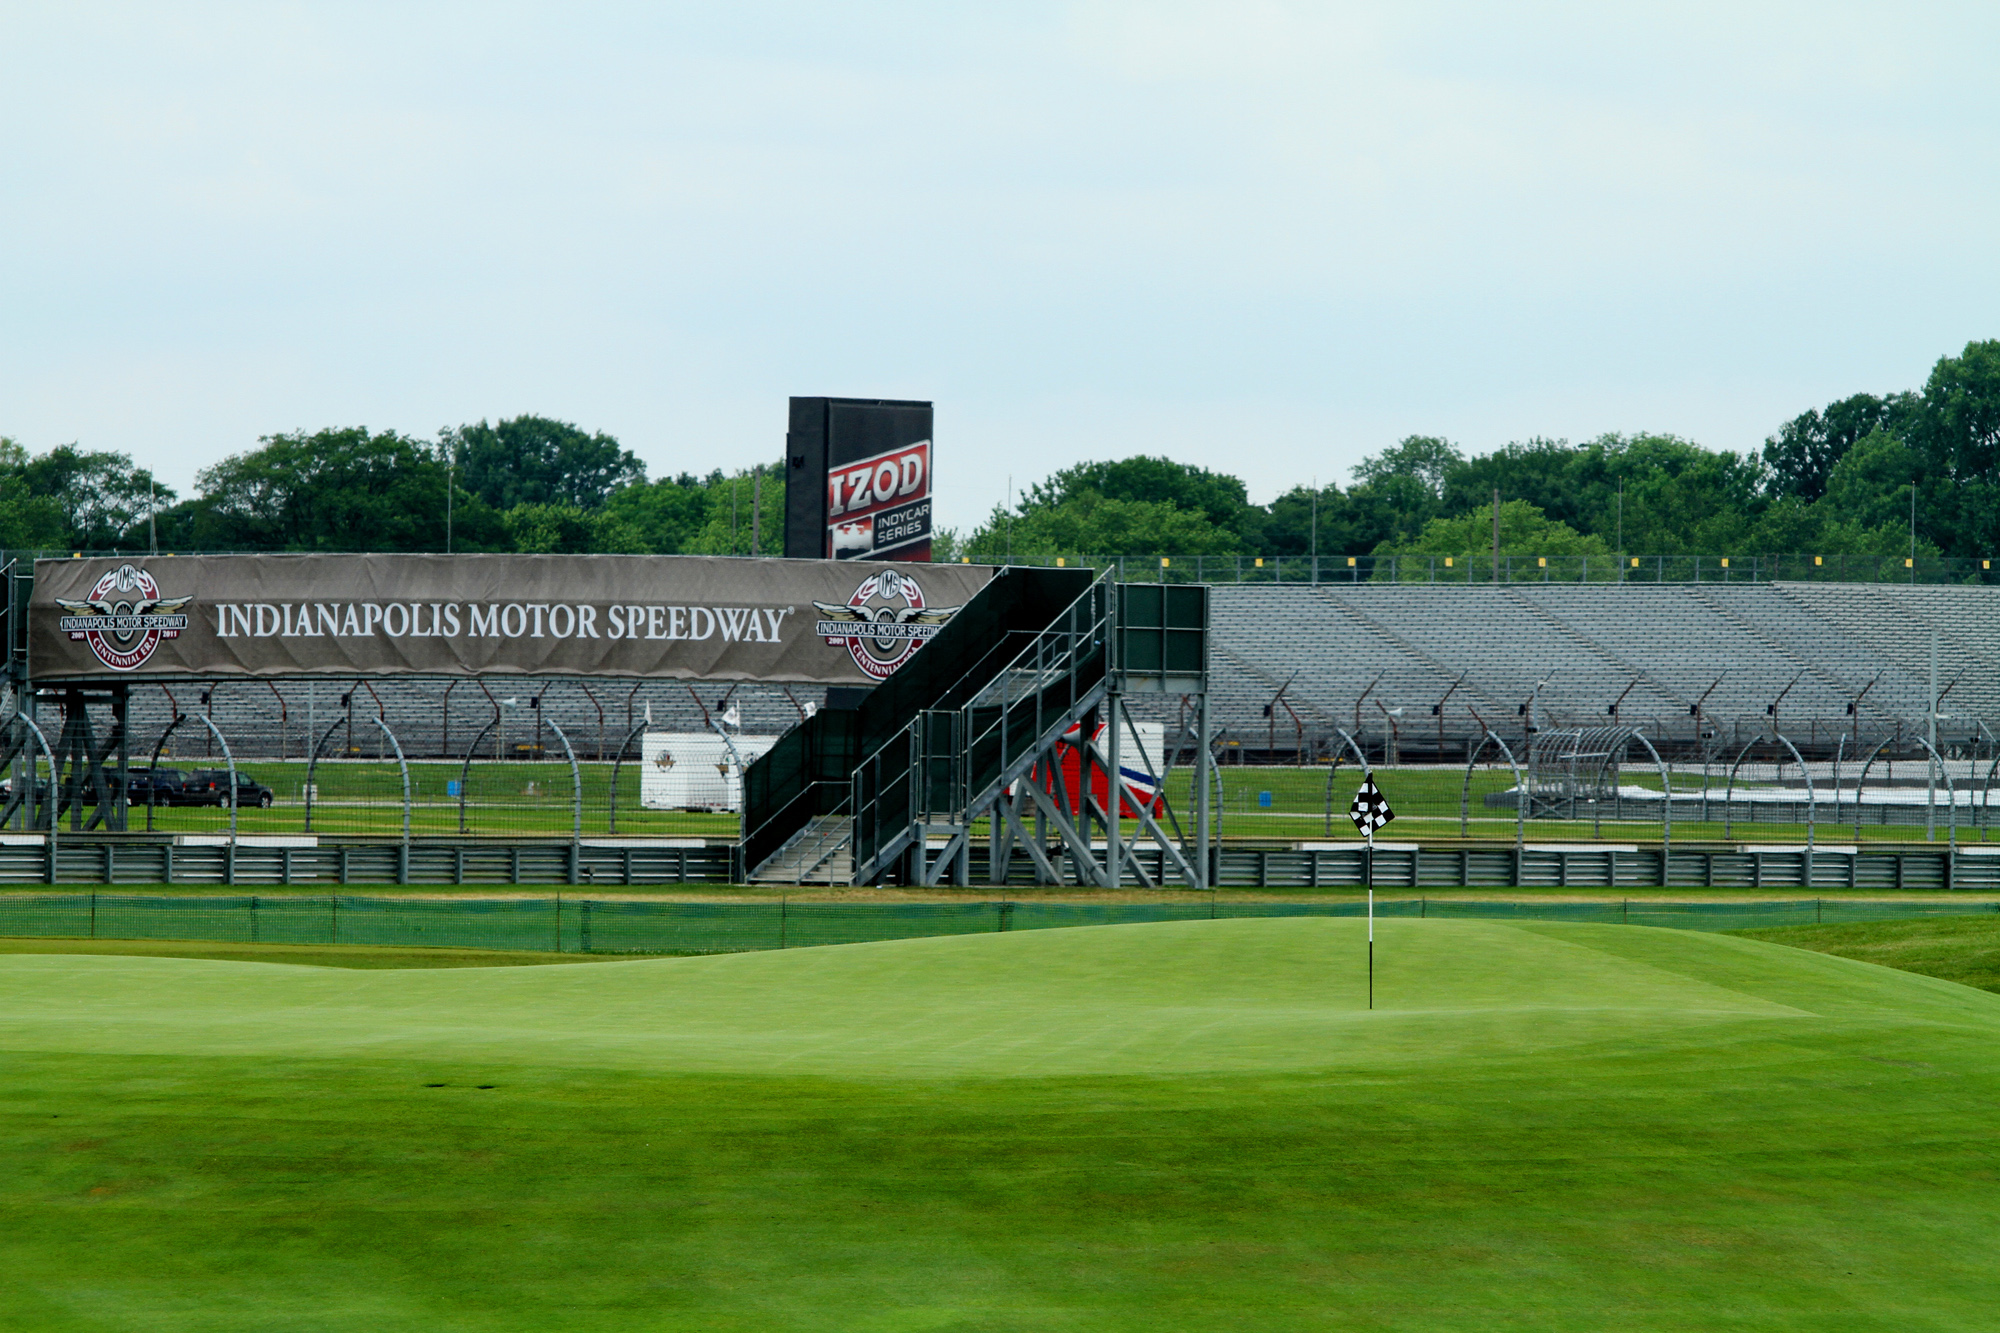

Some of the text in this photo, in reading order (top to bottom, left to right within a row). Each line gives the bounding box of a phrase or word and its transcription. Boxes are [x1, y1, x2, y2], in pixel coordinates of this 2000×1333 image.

[830, 453, 923, 517] IZOD
[878, 504, 930, 529] INDYCAR
[878, 520, 922, 543] SERIES
[64, 616, 184, 629] INDIANAPOLIS MOTOR SPEEDWAY
[216, 603, 461, 638] INDIANAPOLIS
[468, 603, 600, 639] MOTOR
[820, 622, 875, 636] INDIANAPOLIS
[877, 624, 906, 637] MOTOR
[162, 630, 177, 638] 2011
[828, 637, 845, 645] 2009
[93, 636, 156, 666] CENTENNIAL ERA
